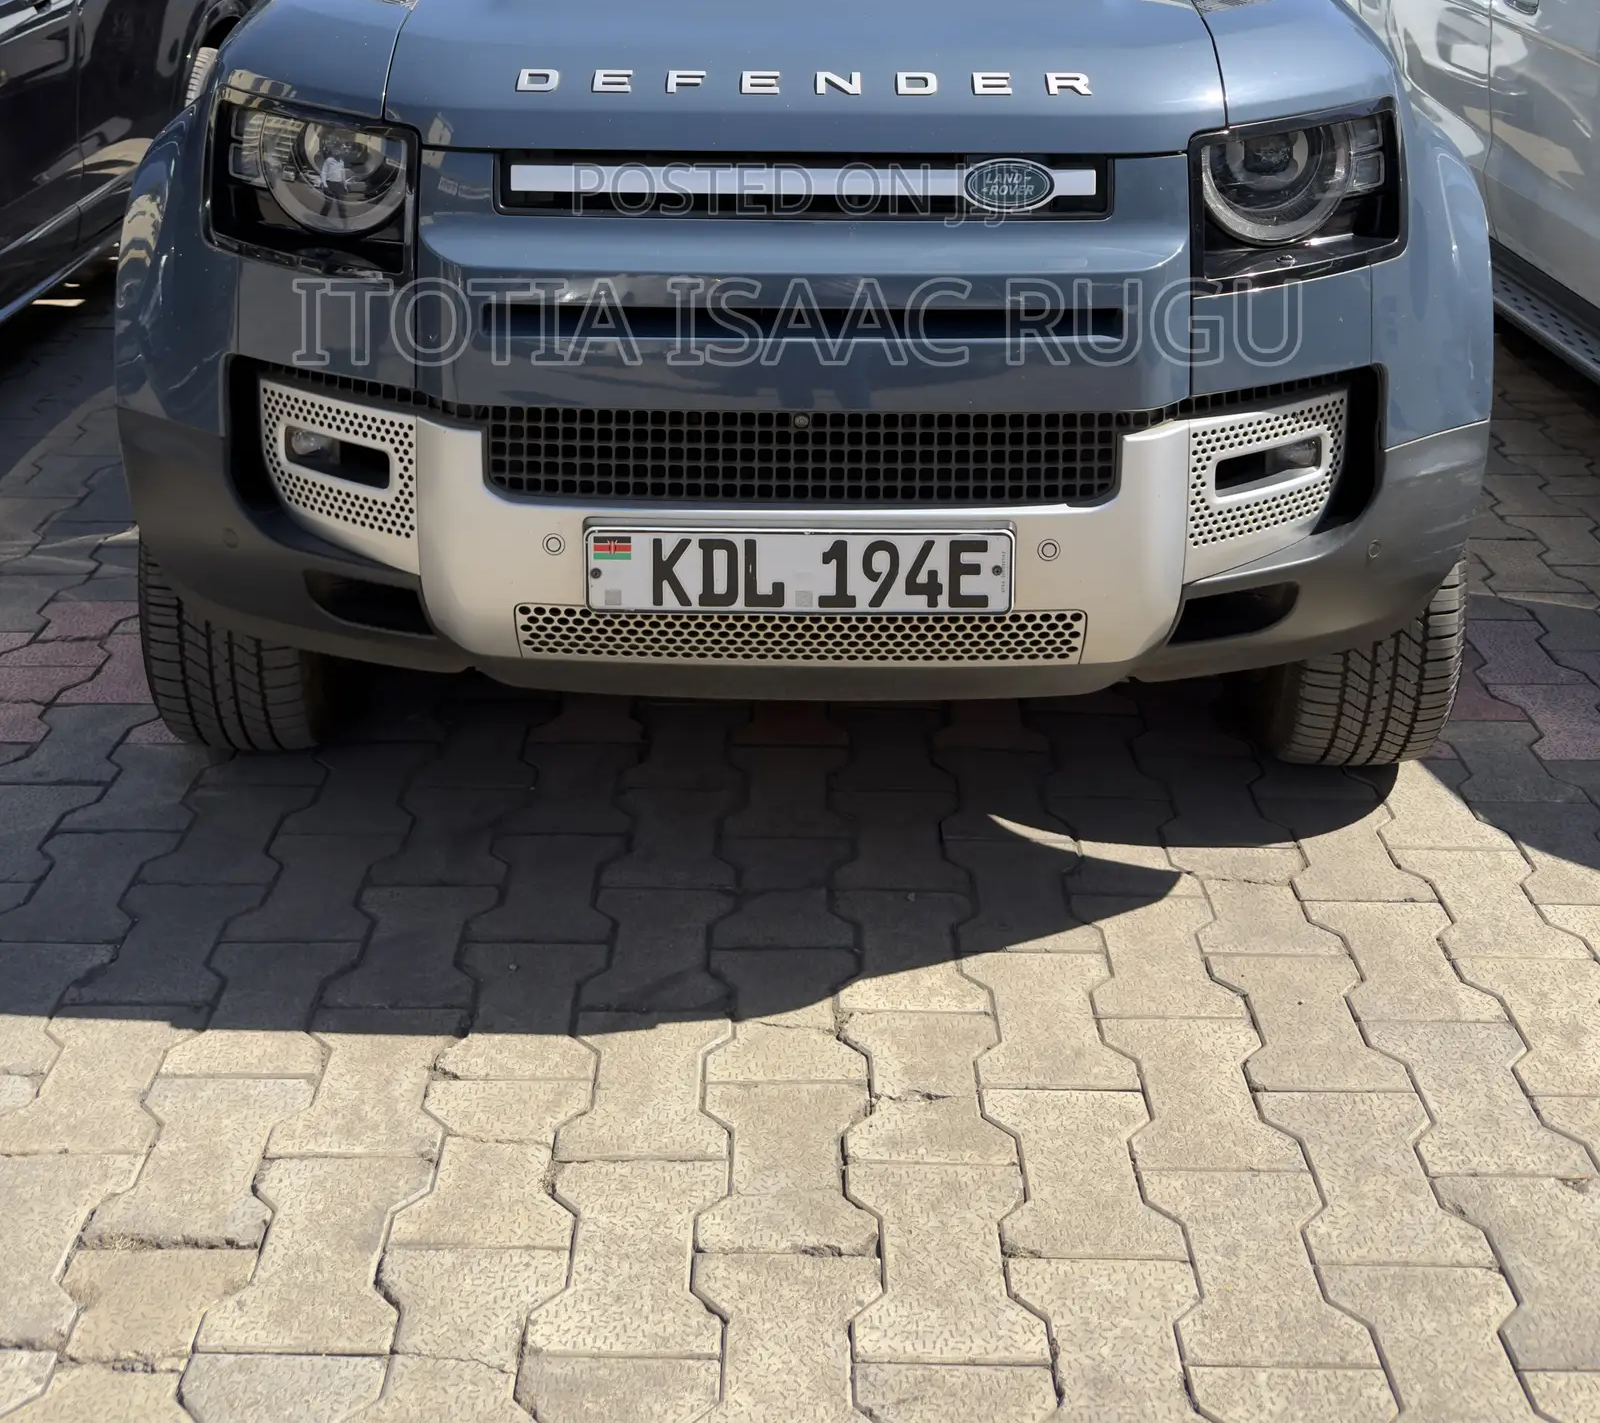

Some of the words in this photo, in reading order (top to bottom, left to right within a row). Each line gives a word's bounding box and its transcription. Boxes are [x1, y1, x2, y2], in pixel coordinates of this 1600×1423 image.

[515, 68, 1093, 97] DEFENDER
[986, 173, 1022, 184] LAND
[989, 184, 1034, 196] ROVER
[652, 538, 785, 608] KDL
[817, 539, 989, 609] 194E
